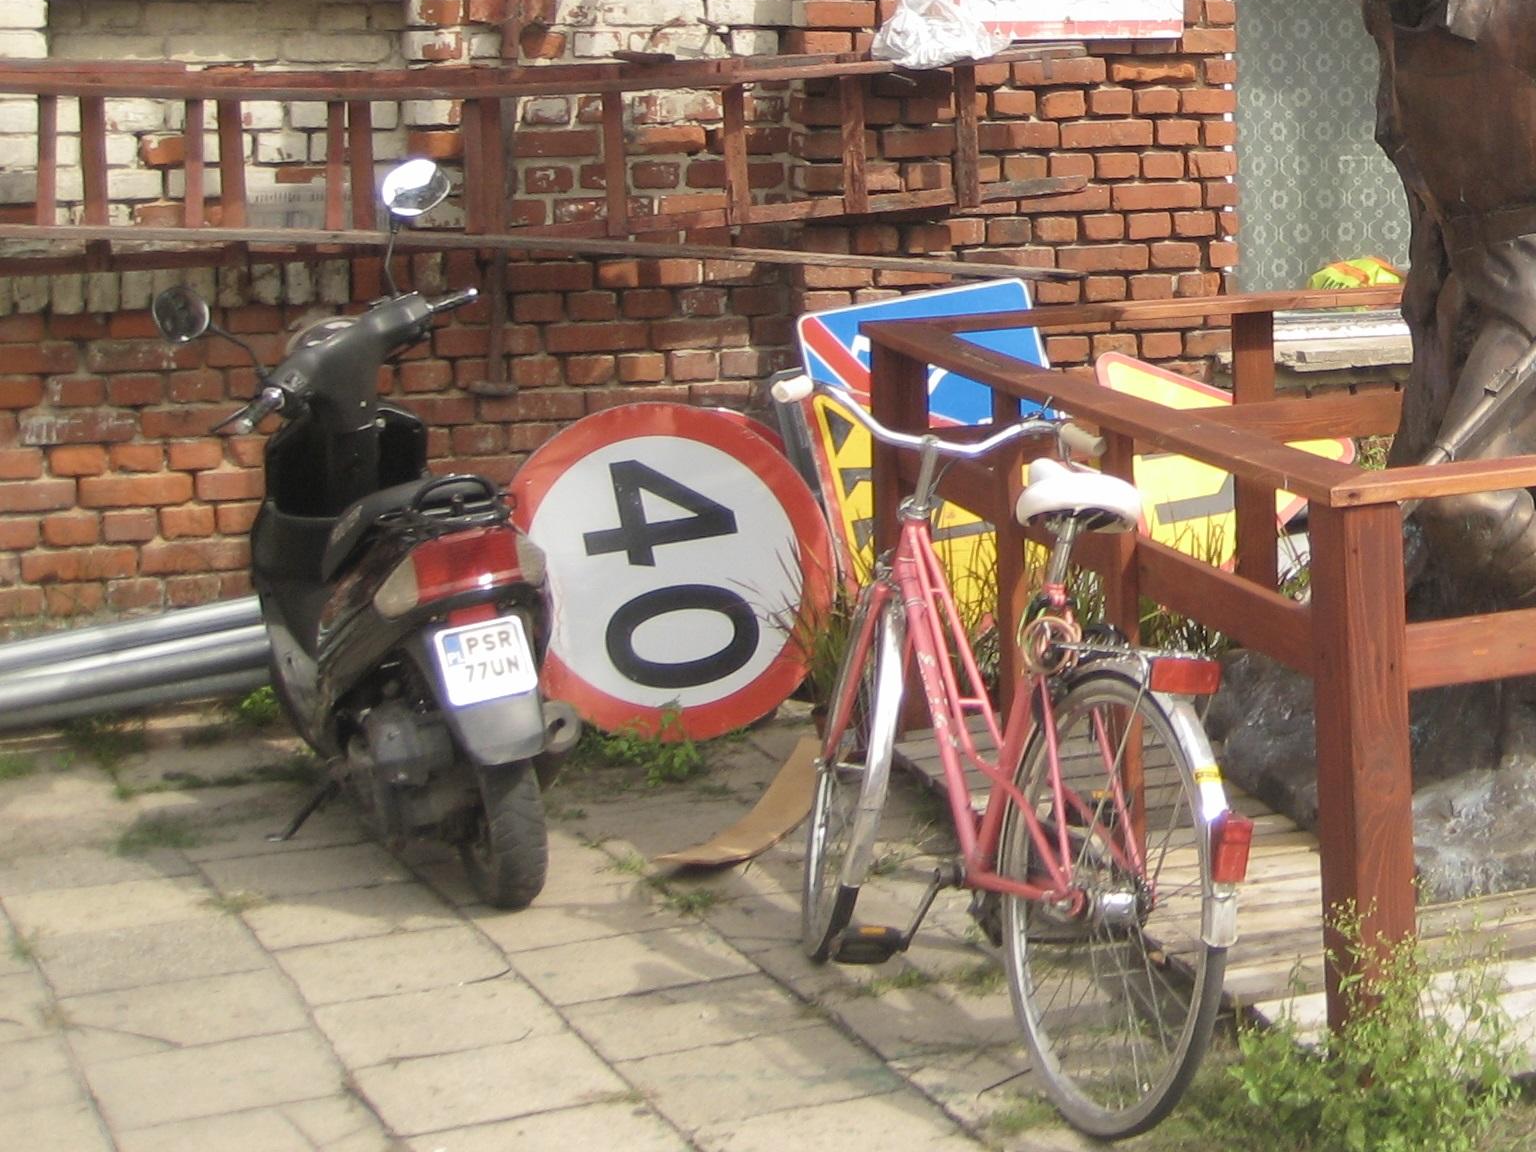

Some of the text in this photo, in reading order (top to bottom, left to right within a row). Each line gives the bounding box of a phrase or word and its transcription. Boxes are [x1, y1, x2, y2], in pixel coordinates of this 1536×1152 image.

[583, 459, 760, 689] 40
[465, 630, 513, 655] PSR
[465, 655, 520, 683] 77UN
